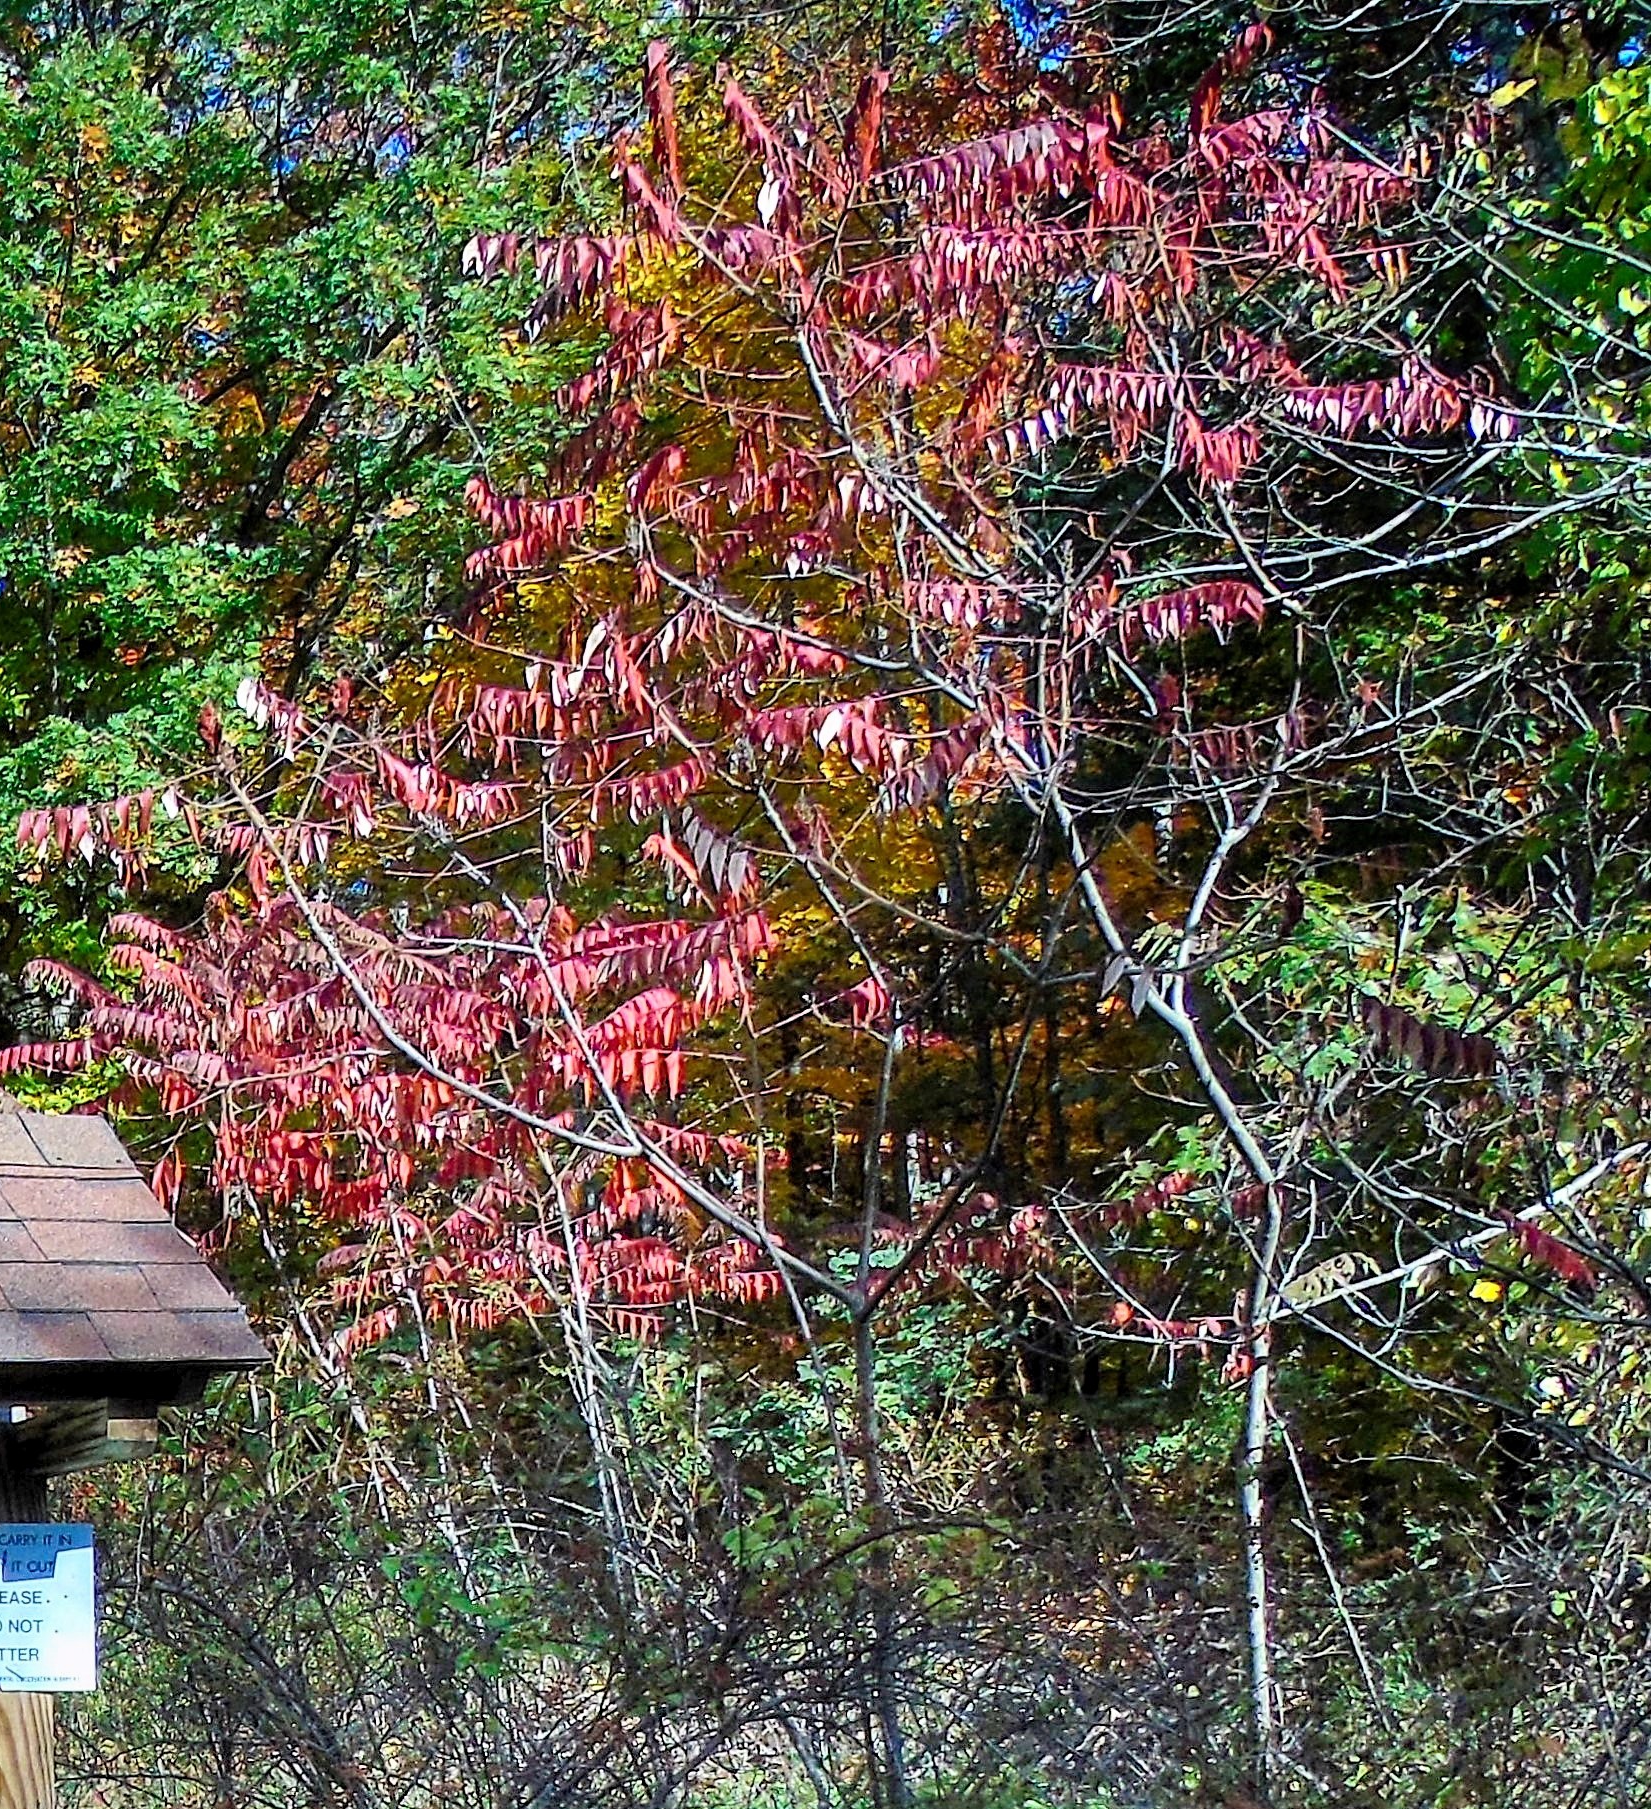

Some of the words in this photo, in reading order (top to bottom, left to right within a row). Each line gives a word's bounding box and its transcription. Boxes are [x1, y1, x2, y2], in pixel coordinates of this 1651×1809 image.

[43, 1534, 52, 1546] IT
[58, 1534, 73, 1546] IN
[11, 1561, 21, 1572] IT
[27, 1561, 54, 1573] OUT
[8, 1619, 43, 1633] NOT
